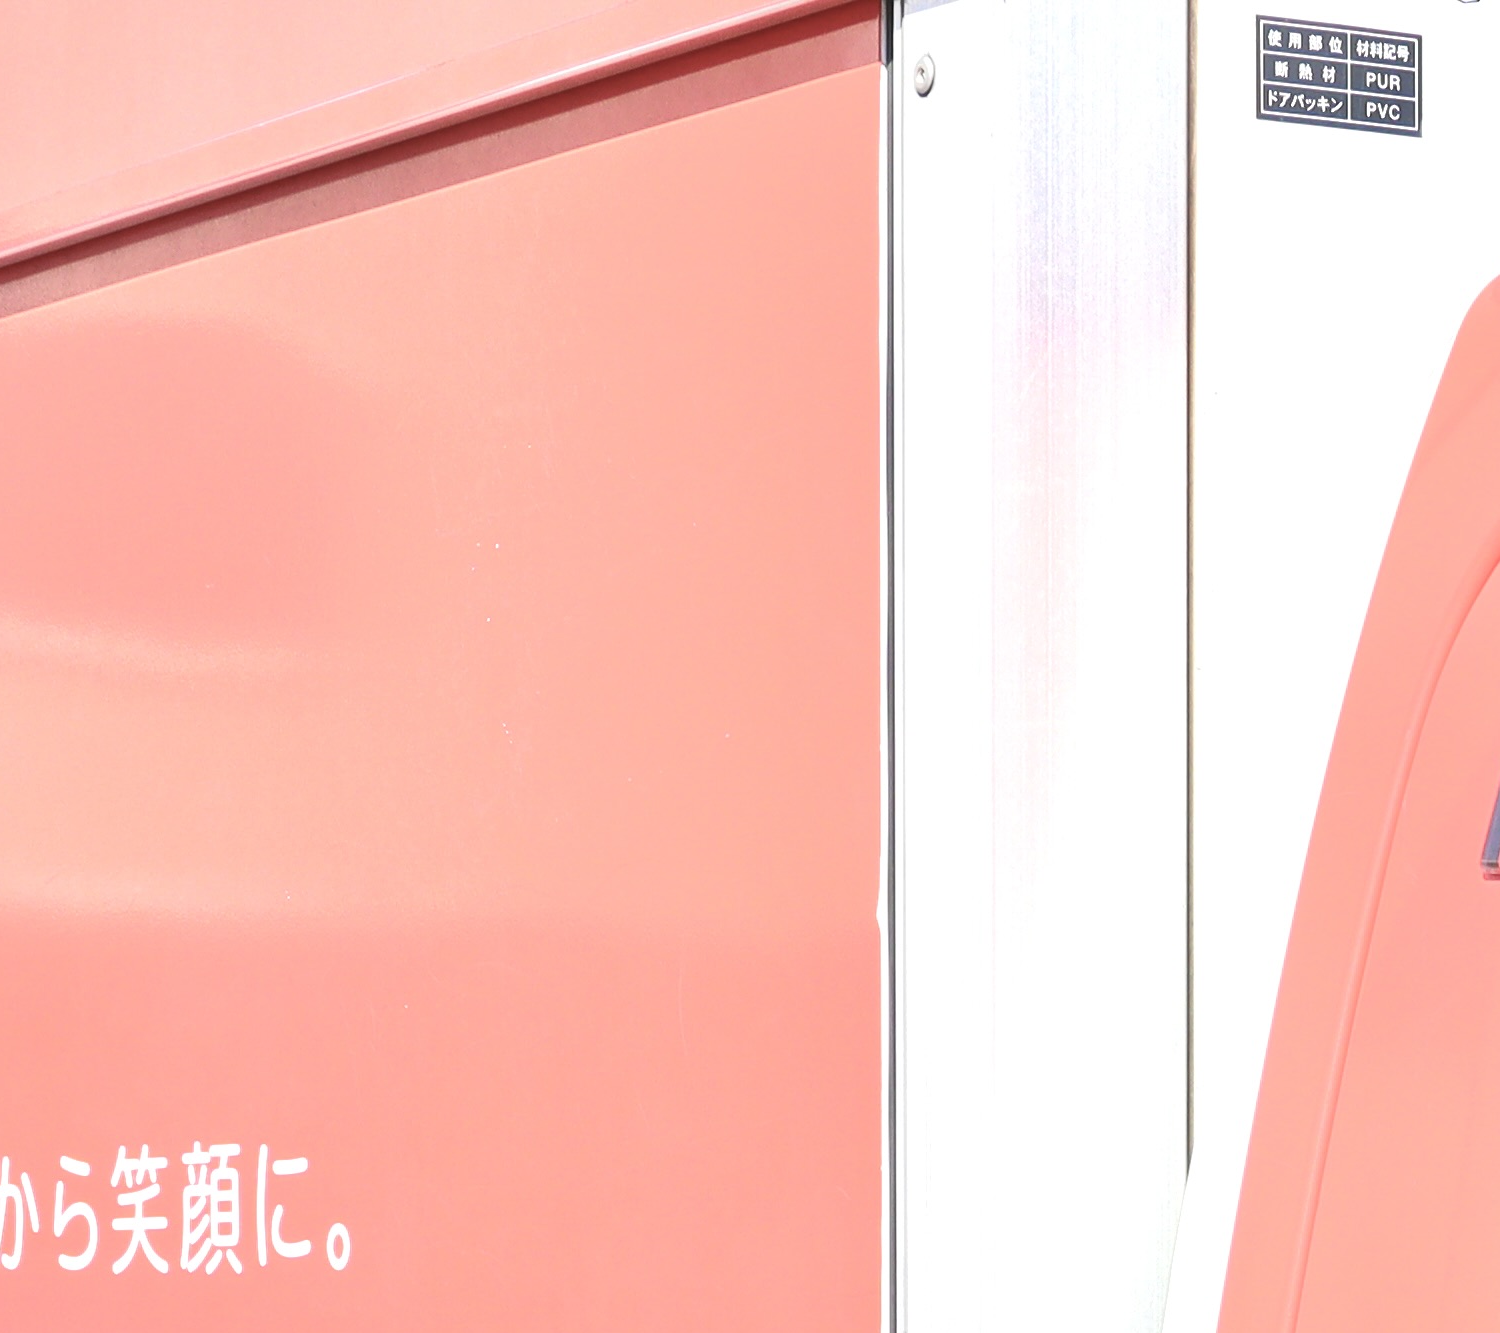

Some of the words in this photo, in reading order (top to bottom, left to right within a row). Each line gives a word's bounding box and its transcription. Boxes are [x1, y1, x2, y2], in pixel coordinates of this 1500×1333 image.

[1267, 28, 1344, 55] 使用部位
[1355, 39, 1411, 63] 材料記号
[1274, 60, 1337, 84] 断熱材
[1366, 71, 1401, 92] PUR
[1366, 101, 1401, 121] PVC
